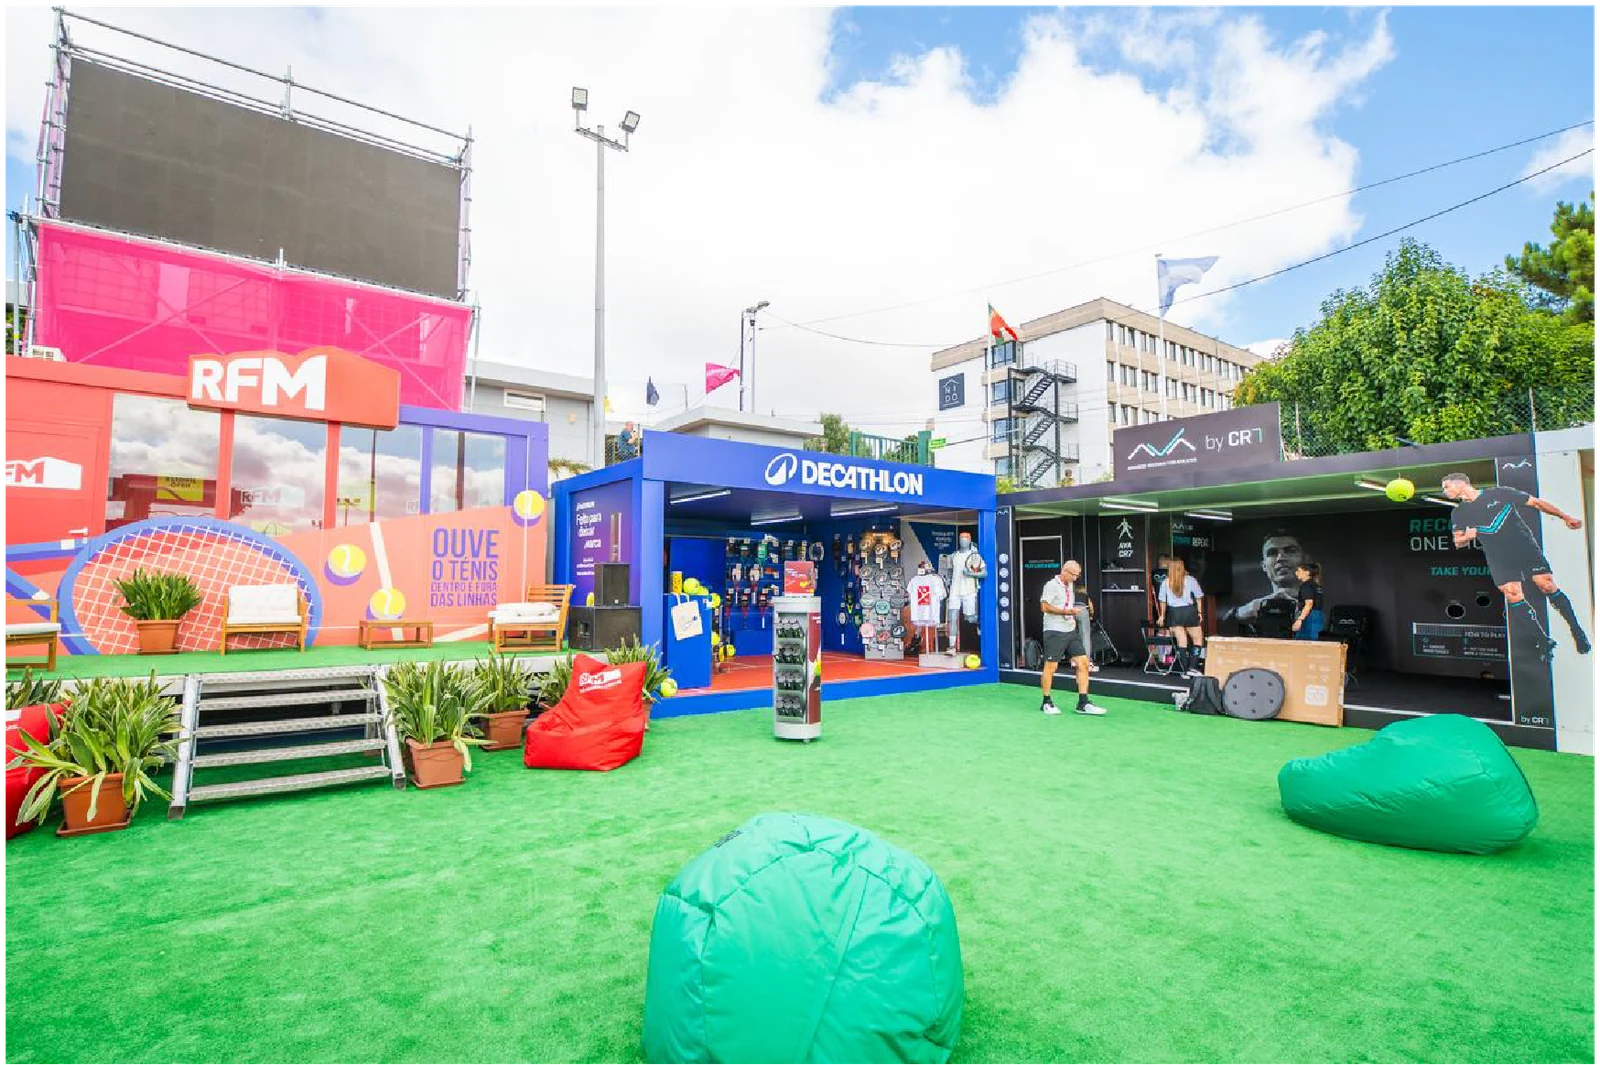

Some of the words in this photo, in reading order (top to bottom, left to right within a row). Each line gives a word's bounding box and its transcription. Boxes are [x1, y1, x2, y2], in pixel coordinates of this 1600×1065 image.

[192, 354, 326, 410] RFM
[1205, 435, 1223, 453] by
[1228, 427, 1264, 446] CR7
[801, 459, 923, 496] DECATHLON
[433, 528, 500, 558] OUVE
[1410, 536, 1449, 551] ONE
[432, 560, 443, 581] O
[1430, 567, 1459, 576] TAKE
[430, 582, 466, 592] DENTRO
[468, 582, 473, 592] E
[476, 582, 497, 592] FORA
[430, 593, 453, 607] DAS
[457, 593, 497, 607] LINHAS
